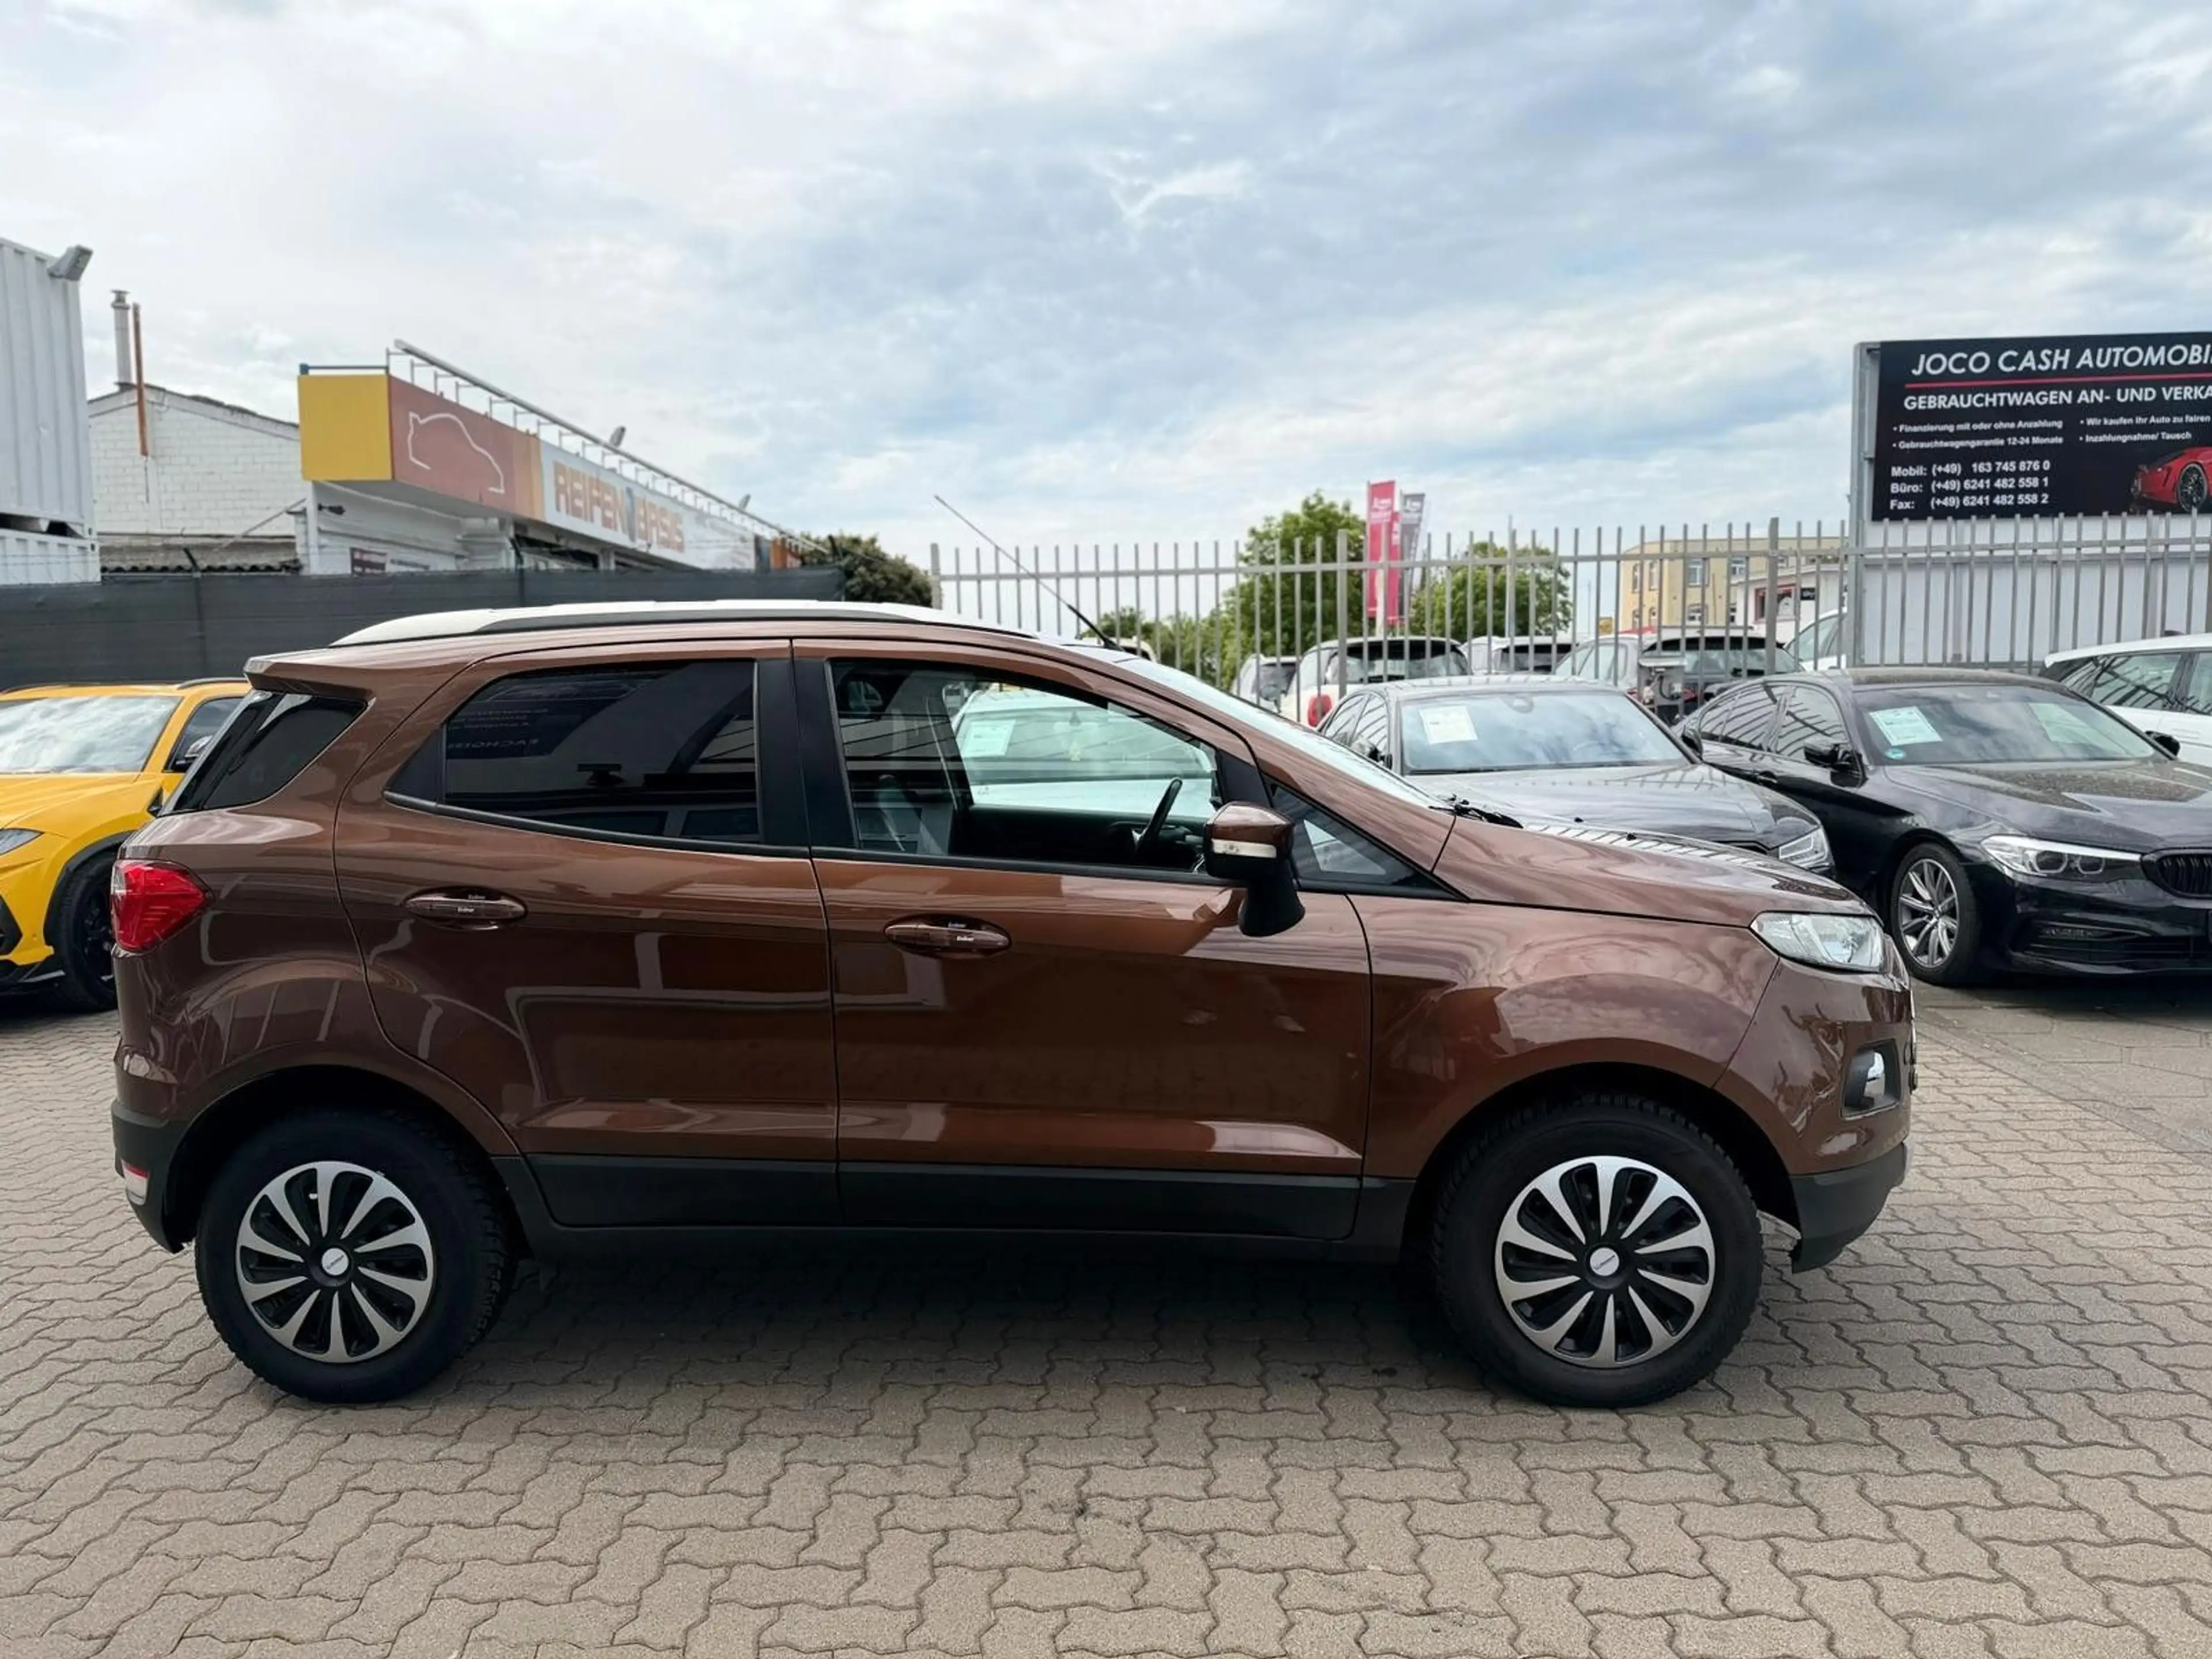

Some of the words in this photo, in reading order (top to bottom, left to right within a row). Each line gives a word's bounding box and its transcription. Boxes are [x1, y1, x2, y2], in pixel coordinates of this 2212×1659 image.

[1911, 351, 1991, 376] JOCO
[1997, 348, 2071, 373] CASH
[2075, 343, 2212, 369] AUTOMOBI
[1903, 389, 2073, 410] GEBRAUCHTWAGEN
[2077, 388, 2110, 404] AN-
[2116, 387, 2157, 403] UND
[1899, 423, 1955, 433] Finanzierung
[1956, 422, 1971, 431] mit
[1971, 421, 1992, 430] oder
[1993, 419, 2016, 430] ohne
[2017, 419, 2063, 430] Anzahlung
[2086, 417, 2102, 426] Wir
[2103, 415, 2133, 426] kaufen
[2135, 415, 2147, 424] Ihr
[2149, 414, 2171, 424] Auto
[1899, 438, 2005, 449] Gebrauchtwagengarantie
[2006, 436, 2030, 446] 12-24
[2032, 435, 2063, 445] Monate
[2161, 431, 2192, 440] Tausch
[1891, 465, 1927, 477] Mobil:
[1932, 463, 1961, 476] (+49)
[1971, 462, 1992, 472] 163
[1995, 461, 2016, 472] 745
[2043, 460, 2051, 471] 0
[1890, 482, 1923, 494] Büro:
[1931, 479, 1961, 493] (+49)
[1963, 479, 1990, 490] 6241
[1994, 478, 2015, 489] 482
[2018, 478, 2039, 488] 558
[2042, 477, 2048, 487] 1
[554, 461, 626, 533] REIFEN
[1890, 499, 1915, 510] Fax:
[1930, 496, 1960, 510] (+49)
[1963, 495, 1990, 506] 6241
[1993, 495, 2014, 506] 482
[2041, 494, 2049, 504] 2
